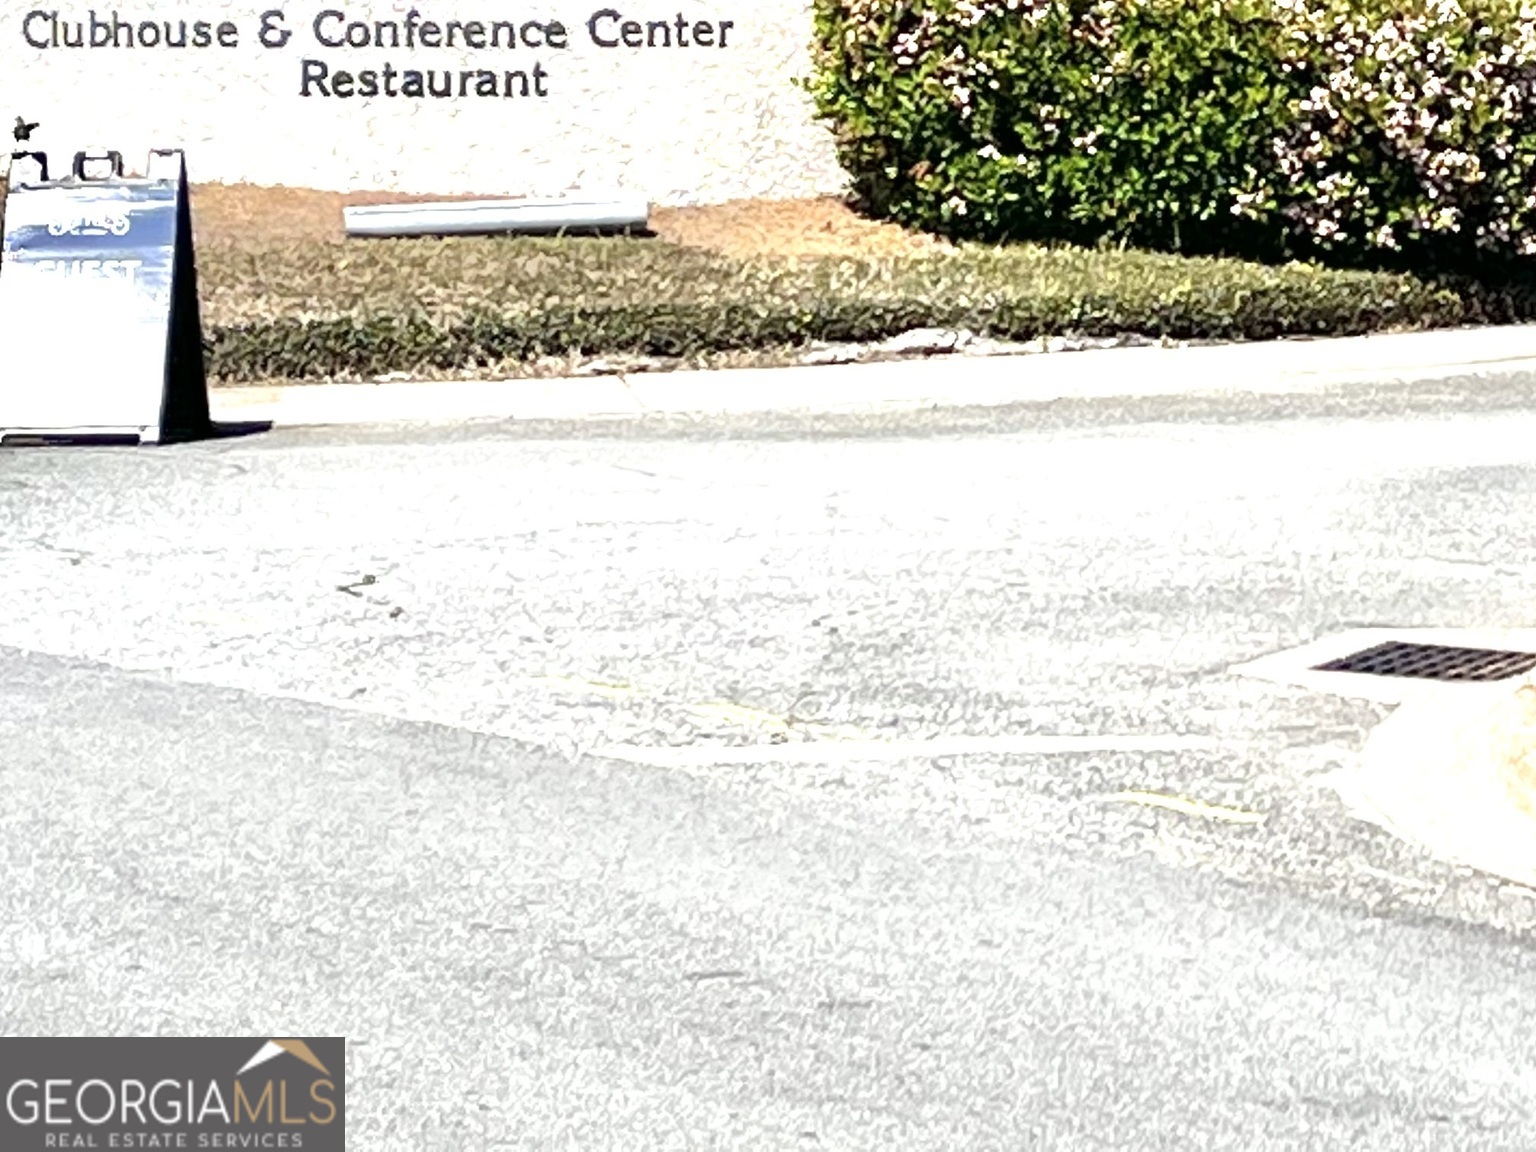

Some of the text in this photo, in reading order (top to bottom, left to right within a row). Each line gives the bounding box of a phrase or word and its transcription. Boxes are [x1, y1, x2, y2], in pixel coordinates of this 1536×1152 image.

[22, 8, 734, 50] Clubhouse & Conference Center
[299, 59, 549, 99] Restaurant
